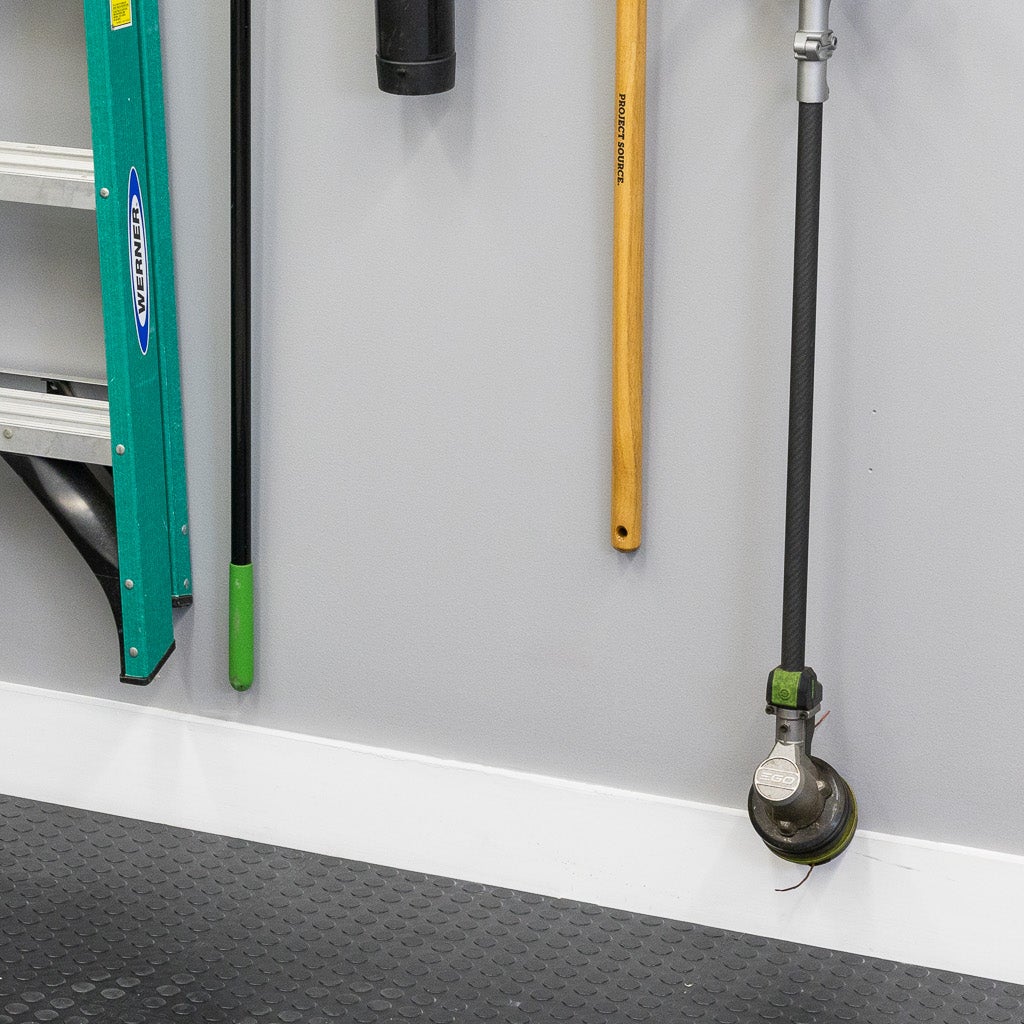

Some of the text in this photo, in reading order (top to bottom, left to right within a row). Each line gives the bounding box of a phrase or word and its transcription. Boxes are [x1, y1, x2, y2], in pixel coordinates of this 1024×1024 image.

[617, 94, 626, 140] PROJECT
[132, 207, 146, 315] WERNER
[759, 772, 795, 785] EGO
